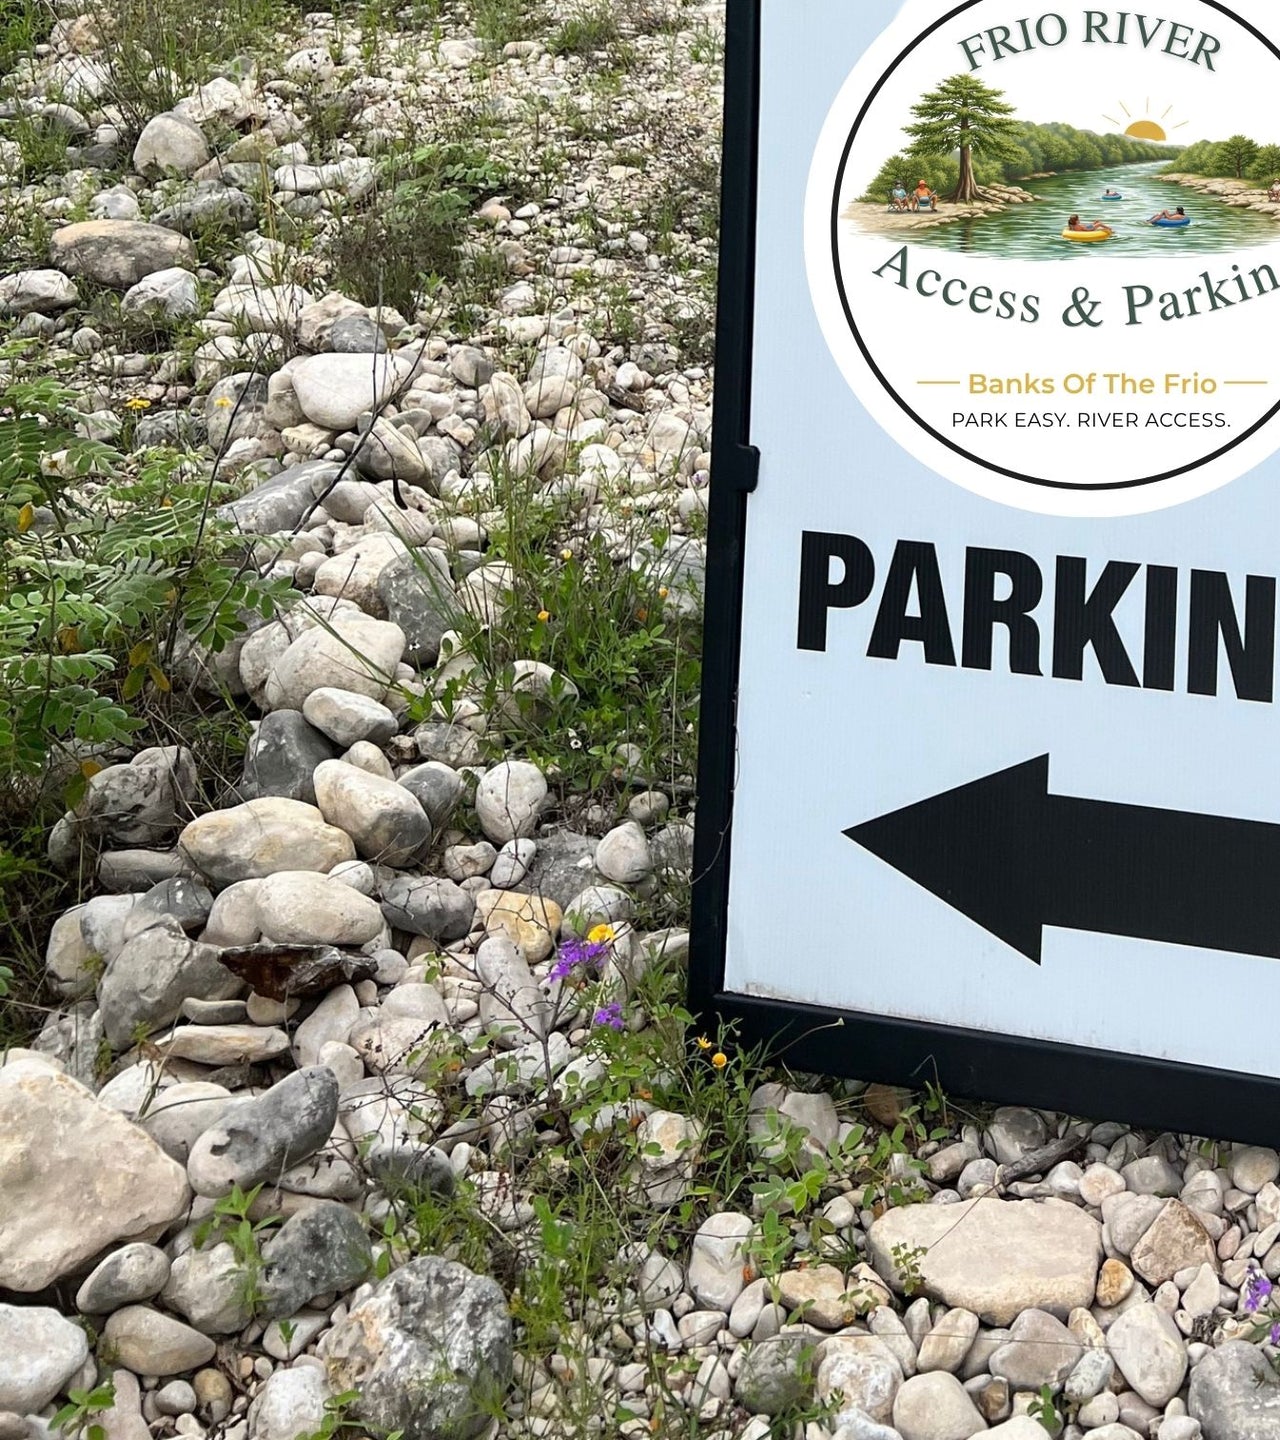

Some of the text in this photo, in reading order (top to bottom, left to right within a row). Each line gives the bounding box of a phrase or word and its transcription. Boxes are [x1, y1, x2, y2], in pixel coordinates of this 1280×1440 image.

[957, 10, 1221, 72] FRIO RIVER
[872, 245, 1040, 323] Access
[1062, 287, 1103, 327] &
[969, 373, 1217, 394] Banks Of The Frio
[953, 412, 1231, 428] PARK EASY. RIVER ACCESS.
